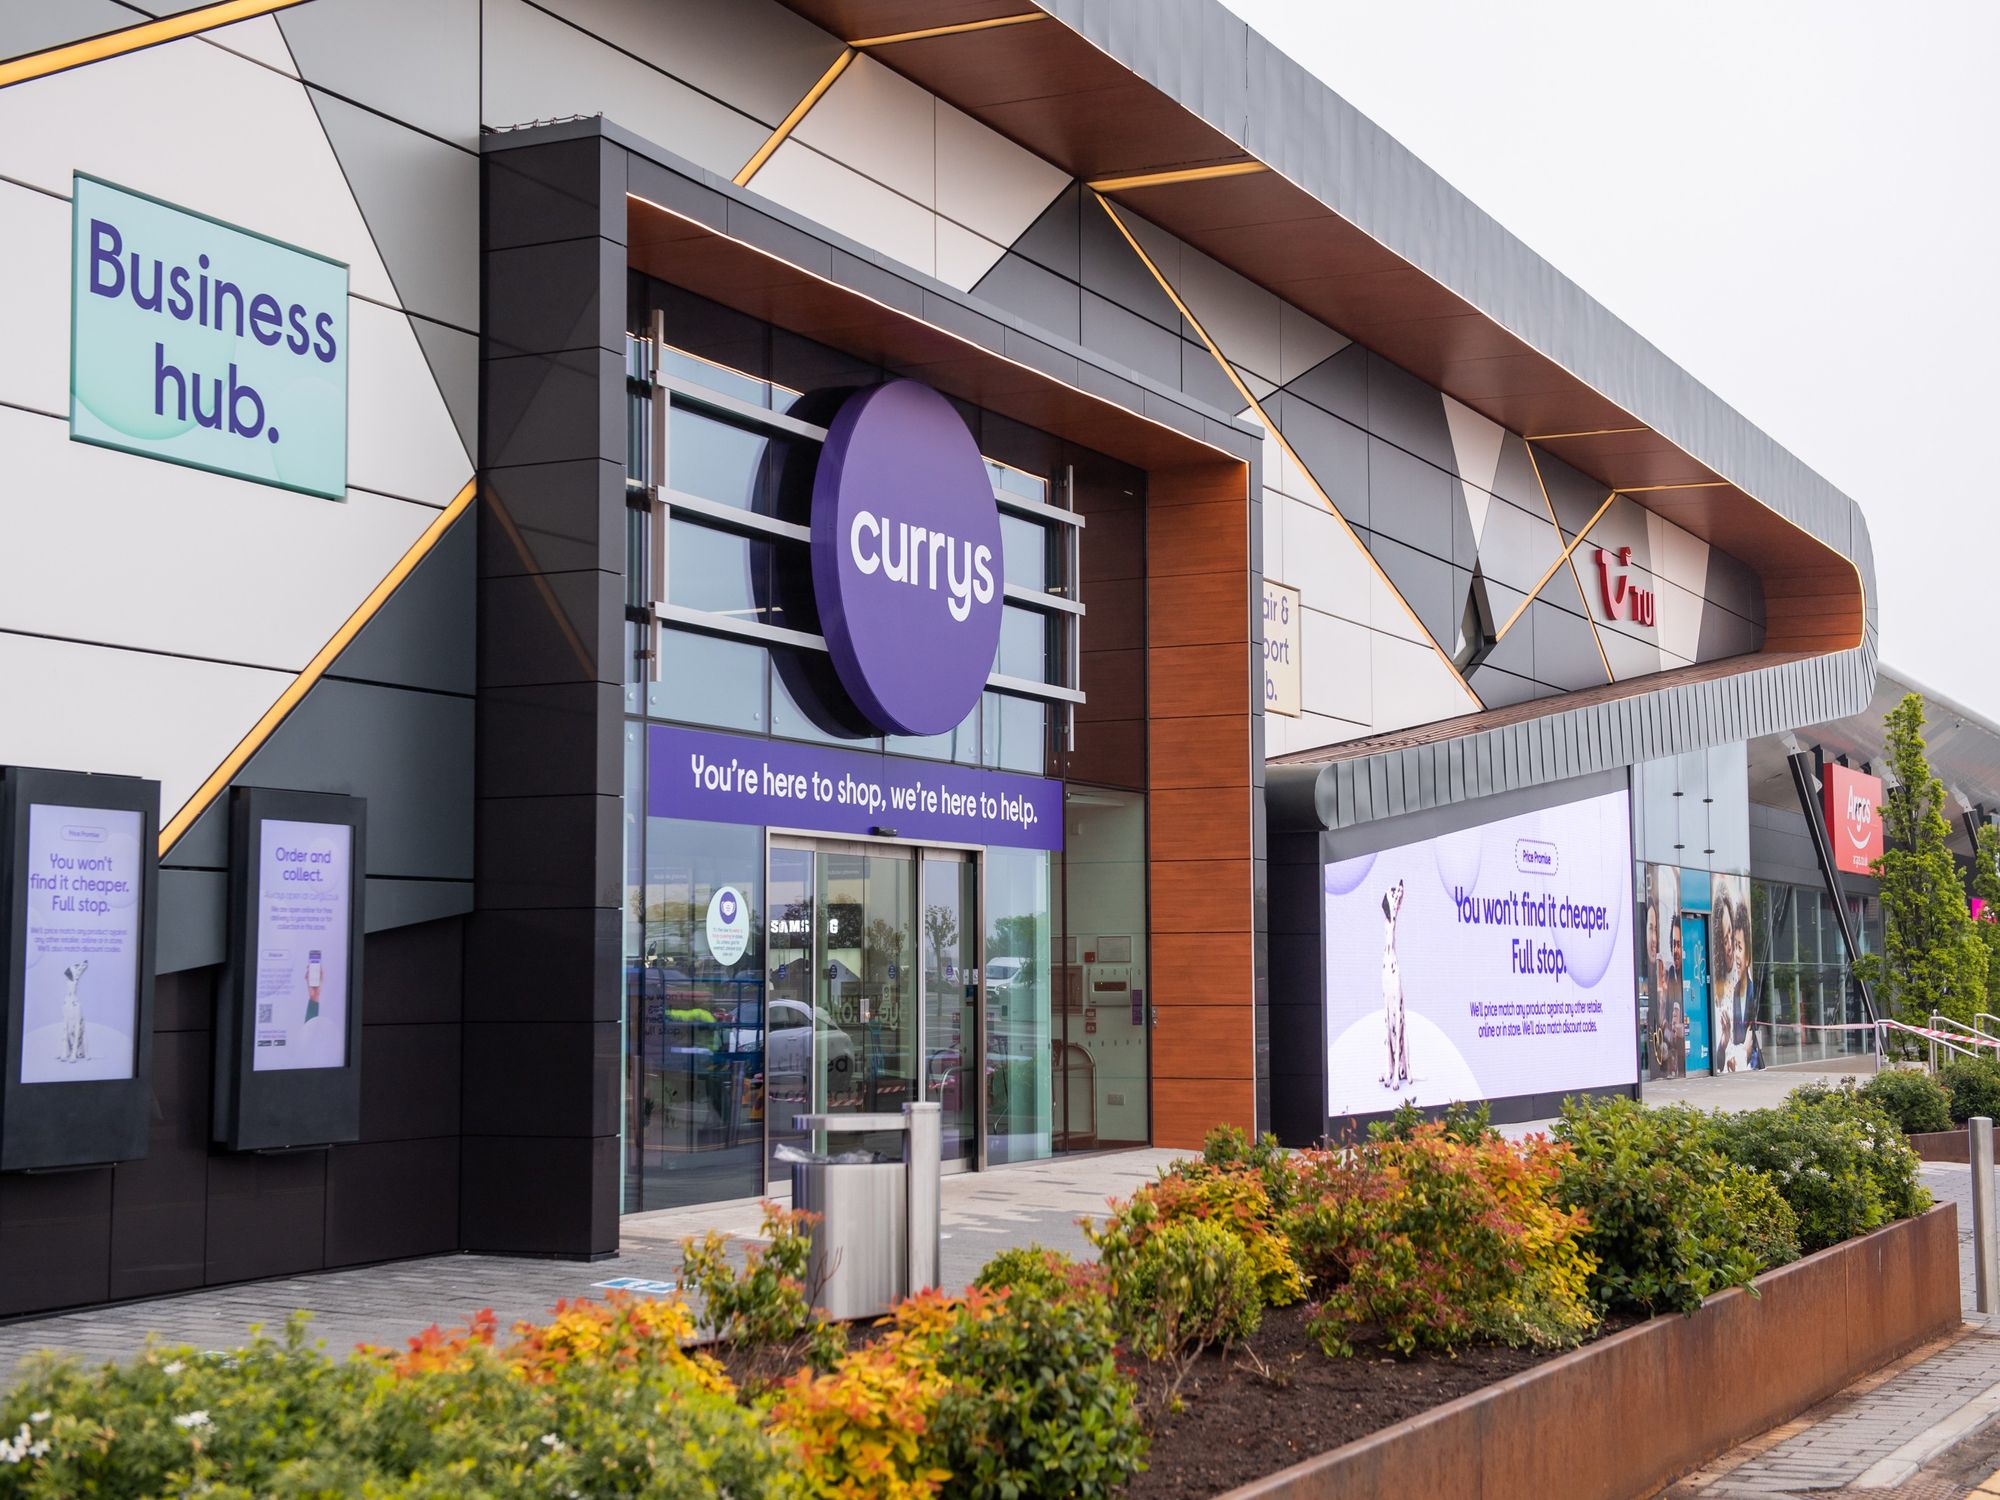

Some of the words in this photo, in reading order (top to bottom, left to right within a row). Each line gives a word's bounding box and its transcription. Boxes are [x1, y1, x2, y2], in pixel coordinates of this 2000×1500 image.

[90, 218, 337, 363] Business
[155, 342, 280, 444] hub.
[850, 510, 995, 622] currys
[1281, 595, 1289, 625] &
[763, 763, 807, 800] here
[811, 771, 833, 802] to
[837, 773, 887, 815] shop,
[941, 784, 976, 817] here
[980, 791, 997, 819] to
[1001, 792, 1038, 830] help.
[1847, 785, 1871, 833] Argos
[50, 853, 74, 870] You
[77, 856, 113, 872] won't
[275, 847, 307, 862] Order
[310, 850, 331, 864] and
[1522, 849, 1534, 863] Price
[1534, 850, 1551, 865] Promise
[30, 873, 57, 890] find
[60, 875, 69, 890] it
[72, 875, 129, 896] cheaper.
[283, 867, 323, 882] collect.
[52, 895, 75, 912] Full
[78, 897, 111, 917] stop.
[1455, 886, 1480, 924] You
[1482, 890, 1519, 926] won't
[1521, 891, 1545, 927] find
[1548, 894, 1557, 928] it
[1559, 895, 1609, 939] cheaper.
[770, 918, 839, 934] SAMSG
[1511, 938, 1535, 975] Full
[1537, 942, 1567, 983] stop.
